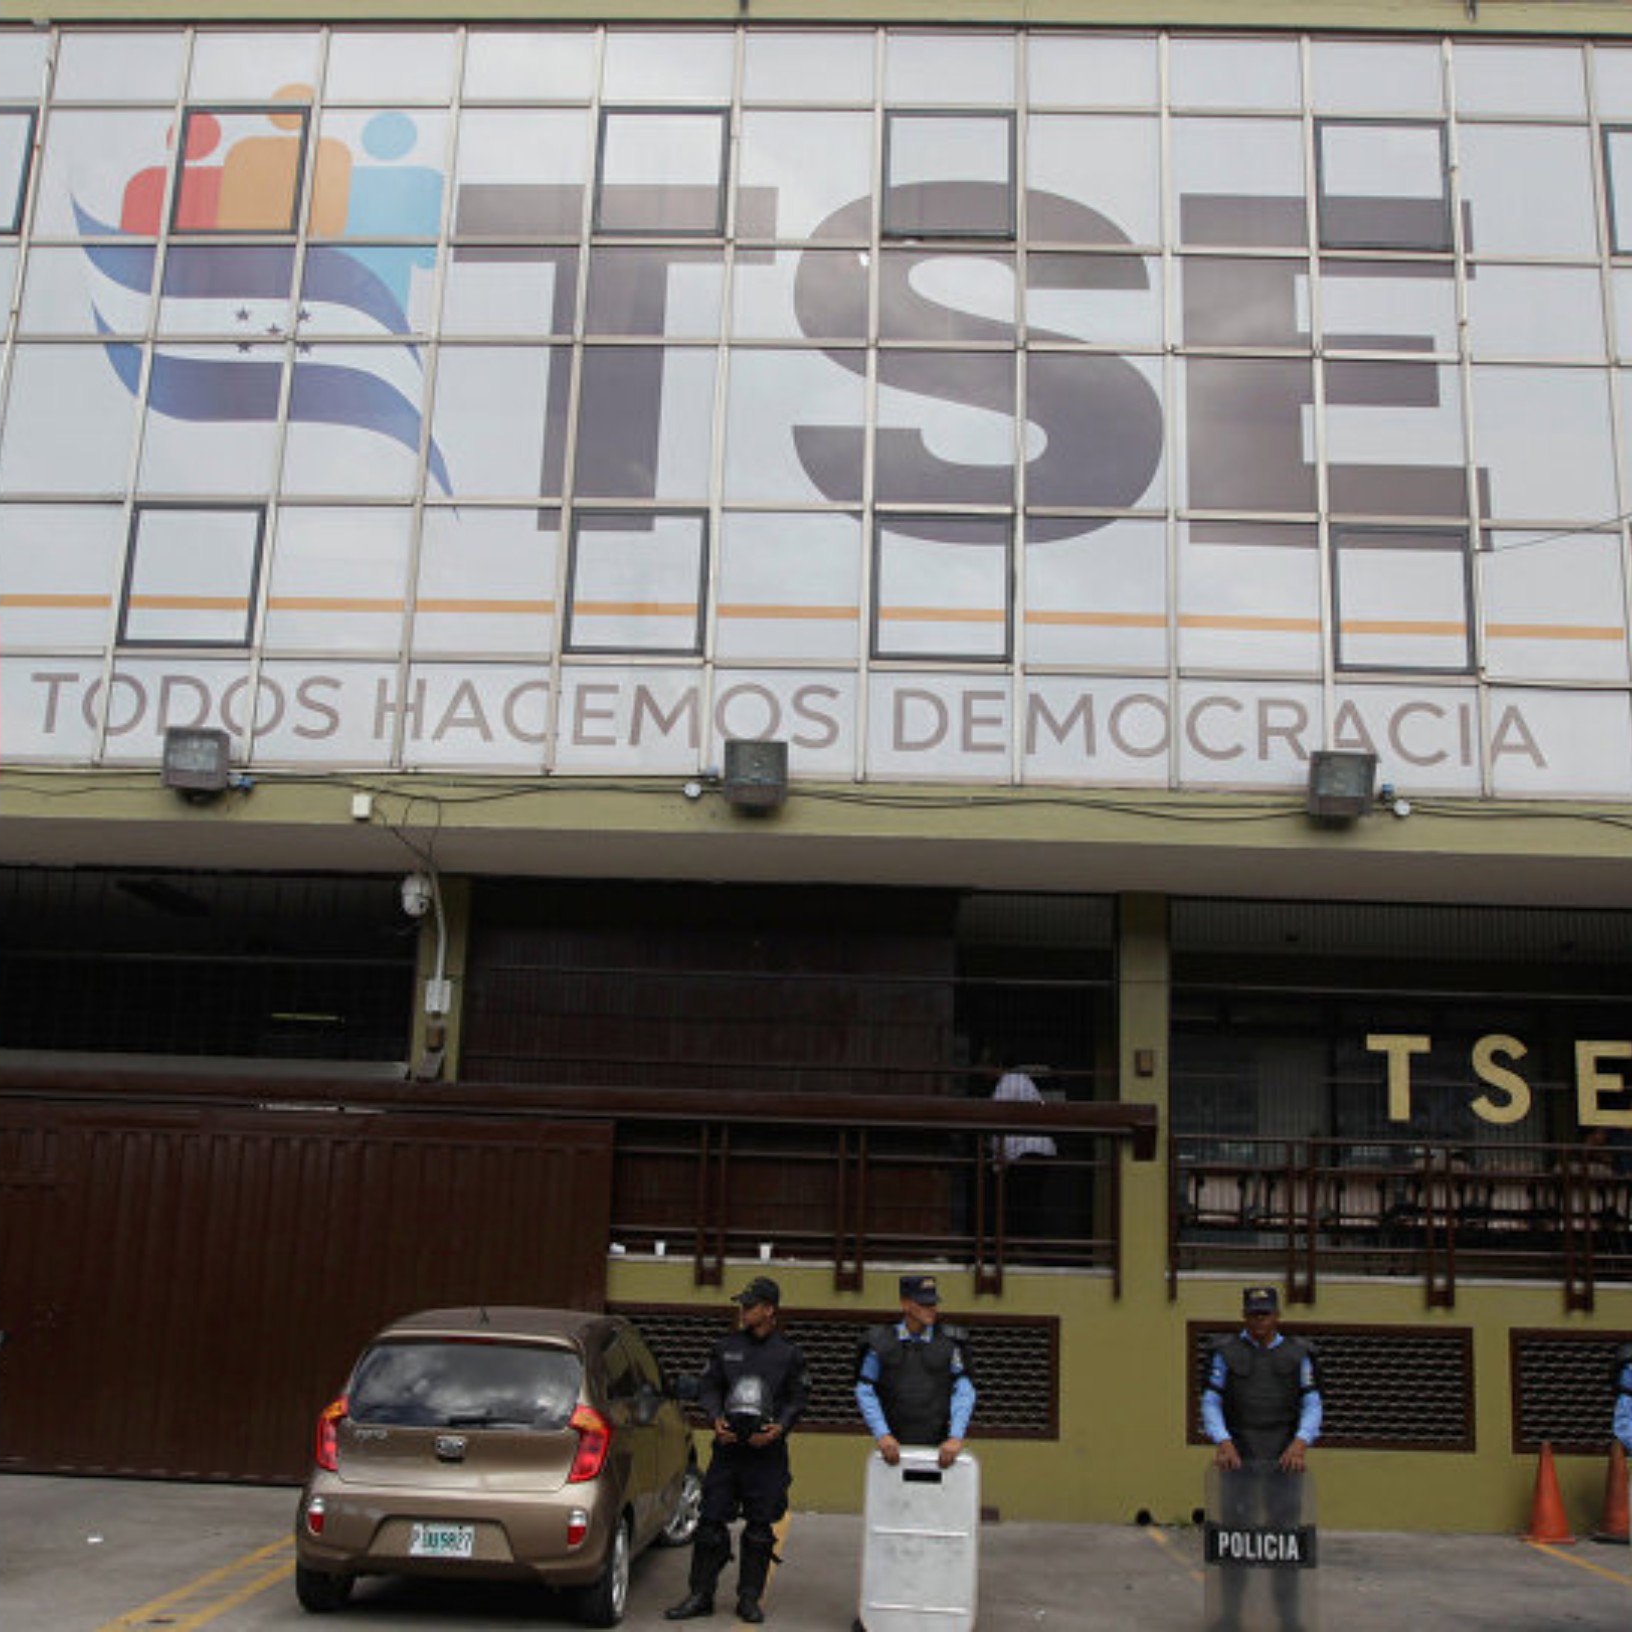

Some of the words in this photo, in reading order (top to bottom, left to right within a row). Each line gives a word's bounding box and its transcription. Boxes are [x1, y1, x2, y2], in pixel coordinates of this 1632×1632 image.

[452, 180, 1493, 551] TSE
[31, 671, 343, 739] TODOS
[373, 677, 840, 749] HACEMOS
[892, 687, 1549, 768] DEMOCRACIA
[1366, 1033, 1632, 1128] TSE
[1218, 1531, 1300, 1561] POLICIA
